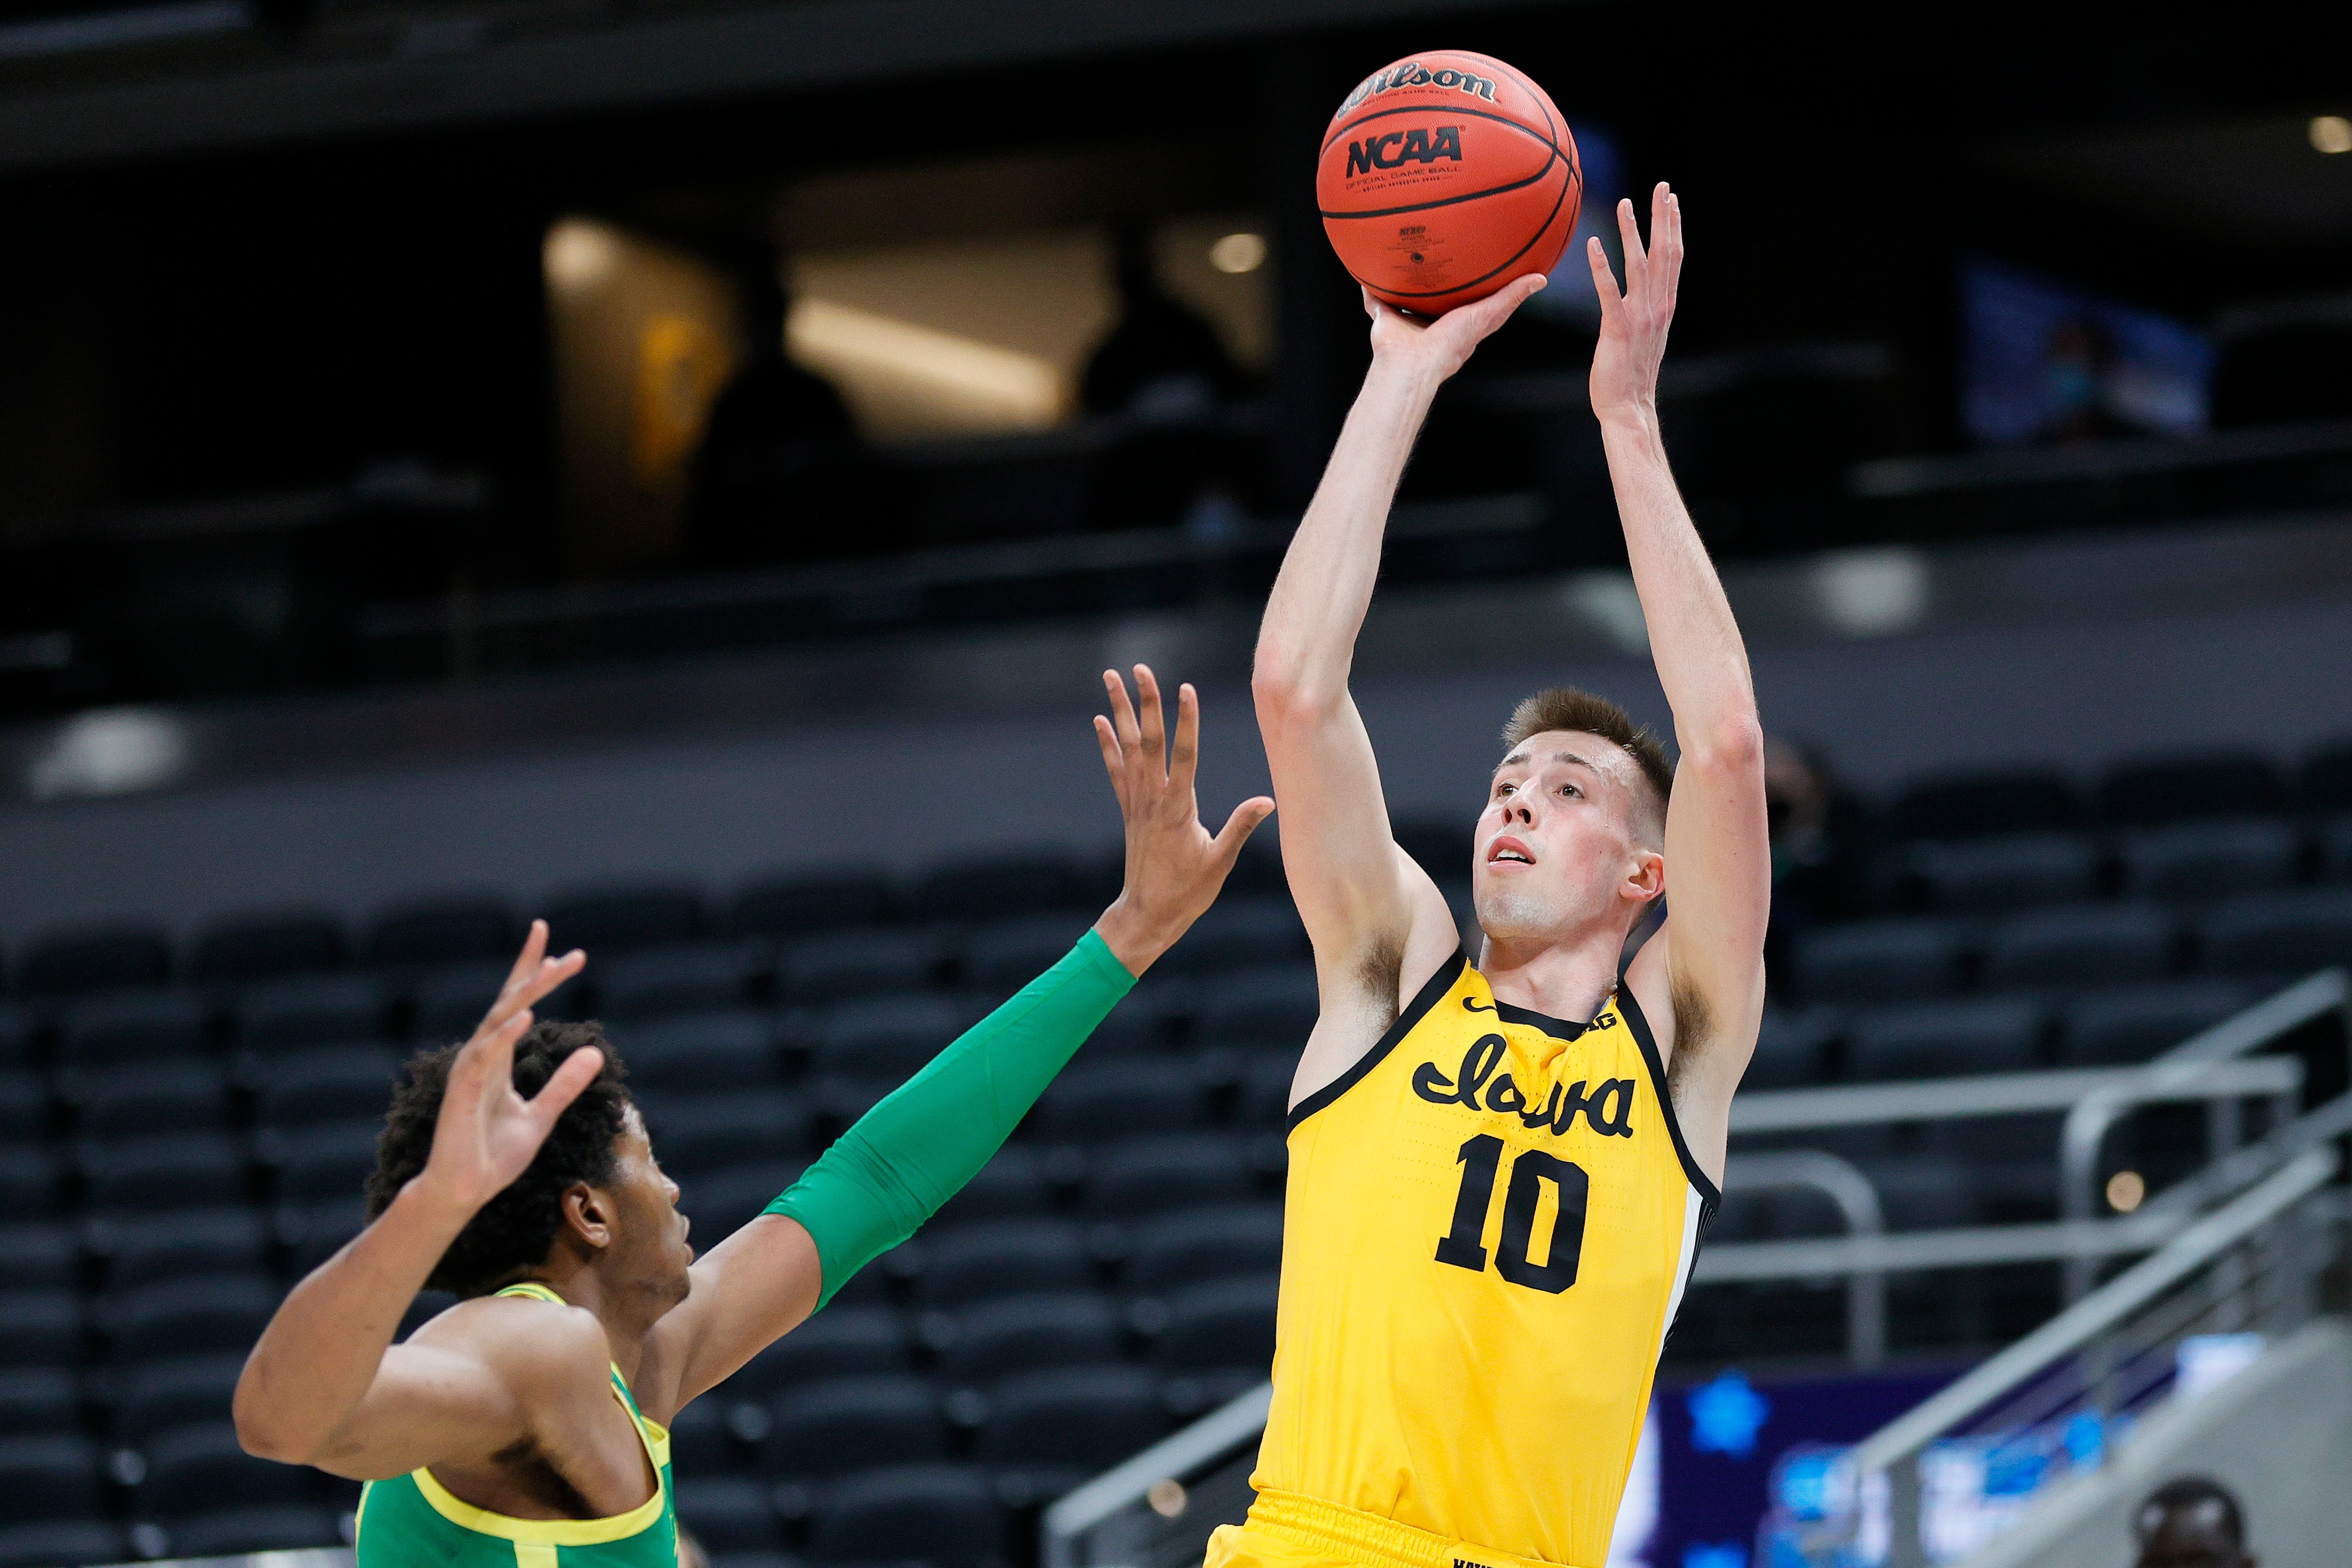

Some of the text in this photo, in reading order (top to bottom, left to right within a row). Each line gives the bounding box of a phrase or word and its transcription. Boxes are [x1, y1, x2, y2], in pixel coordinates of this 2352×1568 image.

[1346, 126, 1462, 178] NCAA
[1412, 1034, 1636, 1138] Iowa
[1435, 1133, 1589, 1295] 10
